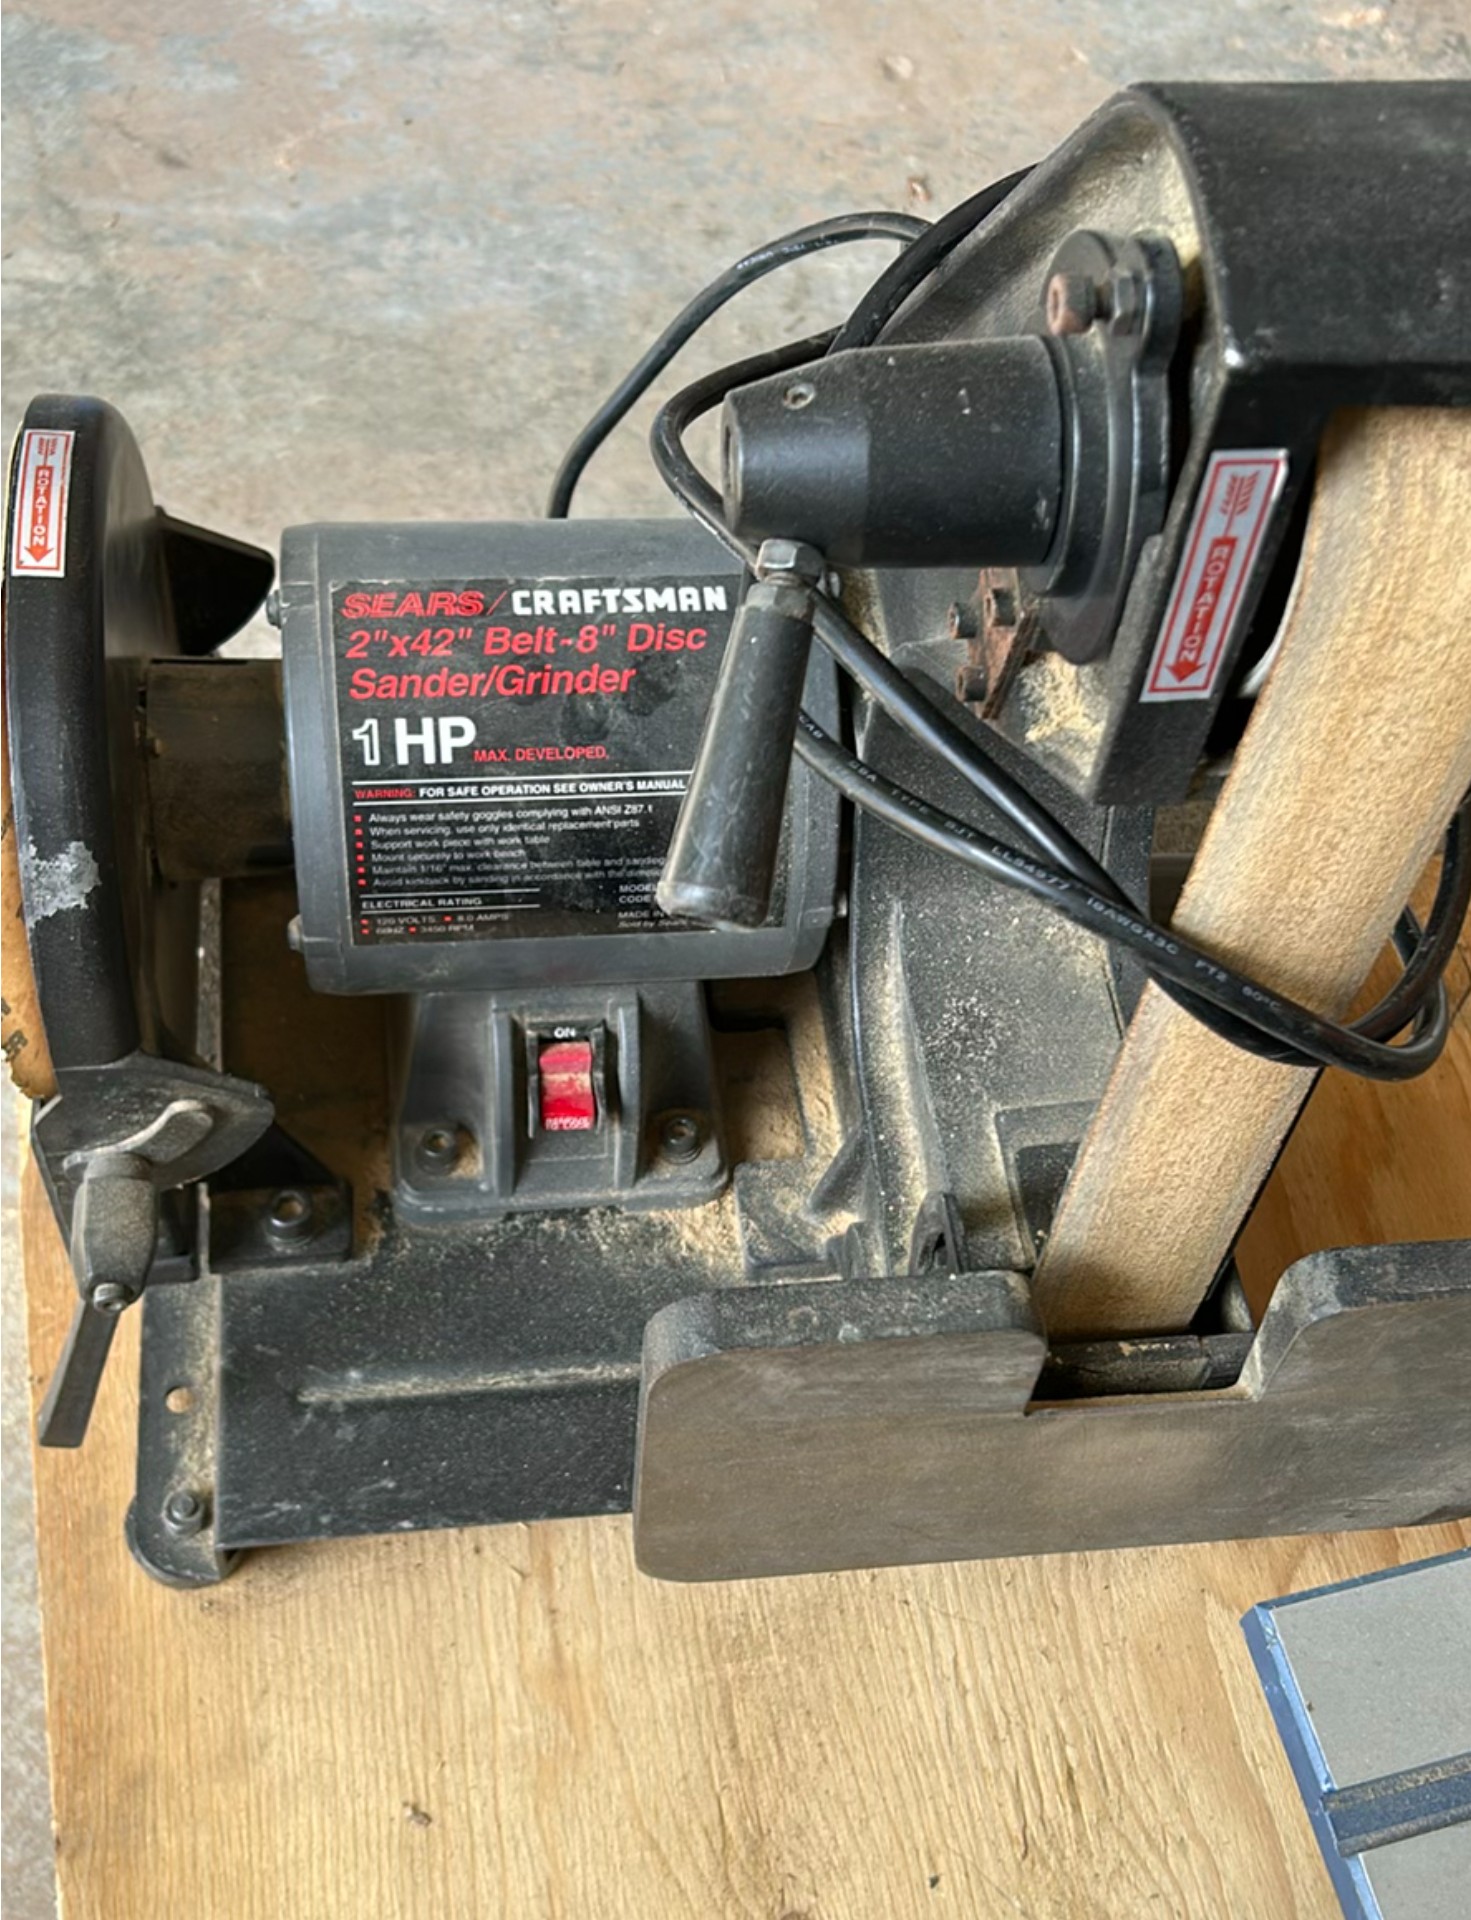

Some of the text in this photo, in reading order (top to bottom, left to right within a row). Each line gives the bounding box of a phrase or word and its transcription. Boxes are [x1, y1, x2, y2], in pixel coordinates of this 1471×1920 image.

[33, 469, 49, 546] ROTATION
[343, 591, 484, 619] SEARS
[511, 586, 727, 616] CRAFTSMAN
[1180, 546, 1230, 661] ROTATION
[345, 627, 473, 659] 2"x42"
[626, 622, 707, 652] Disc
[349, 663, 637, 700] Sander/Grinder
[395, 716, 477, 765] HP
[472, 749, 512, 762] MAX.
[515, 745, 609, 762] DEVELOPED.
[354, 779, 686, 800] WARNING: FOR SAFE OPERATION SEE OWNER'S MANUAL
[369, 812, 407, 824] Always
[409, 812, 435, 822] wear
[437, 811, 470, 822] safety
[471, 810, 513, 822] goggles
[516, 808, 569, 819] complying
[570, 806, 592, 817] with
[593, 804, 622, 816] ANSI
[369, 827, 402, 837] When
[455, 825, 475, 834] use
[478, 823, 500, 835] only
[502, 821, 546, 832] identical
[547, 820, 612, 832] replacement
[613, 819, 640, 829] parts
[370, 839, 412, 851] Support
[414, 839, 440, 848] work
[472, 837, 496, 846] with
[497, 835, 522, 846] work
[524, 835, 550, 845] table
[361, 896, 483, 910] ELECTRICAL RATING
[553, 1026, 577, 1039] ON
